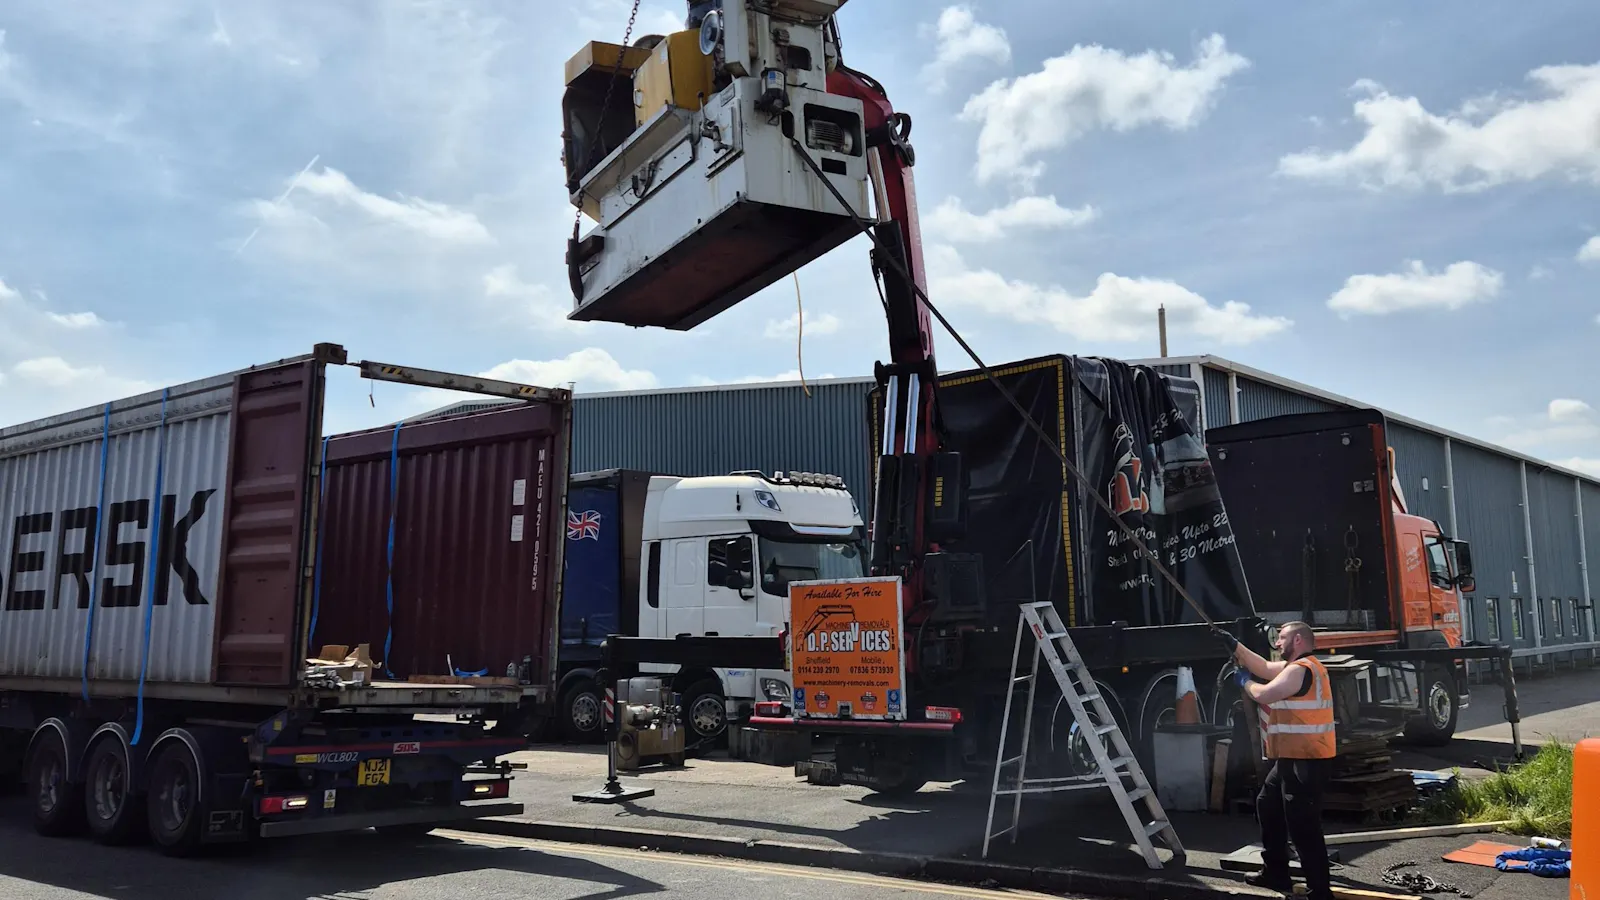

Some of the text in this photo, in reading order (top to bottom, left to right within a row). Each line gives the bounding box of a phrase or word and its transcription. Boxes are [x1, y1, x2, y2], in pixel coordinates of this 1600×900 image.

[0, 488, 217, 611] ERSK
[1179, 545, 1197, 562] 30
[804, 586, 883, 600] Available For Hire
[806, 656, 831, 665] Sheffield
[798, 666, 812, 674] 0114
[803, 679, 890, 688] www.machinery-removals.com
[317, 751, 359, 764] WCL802
